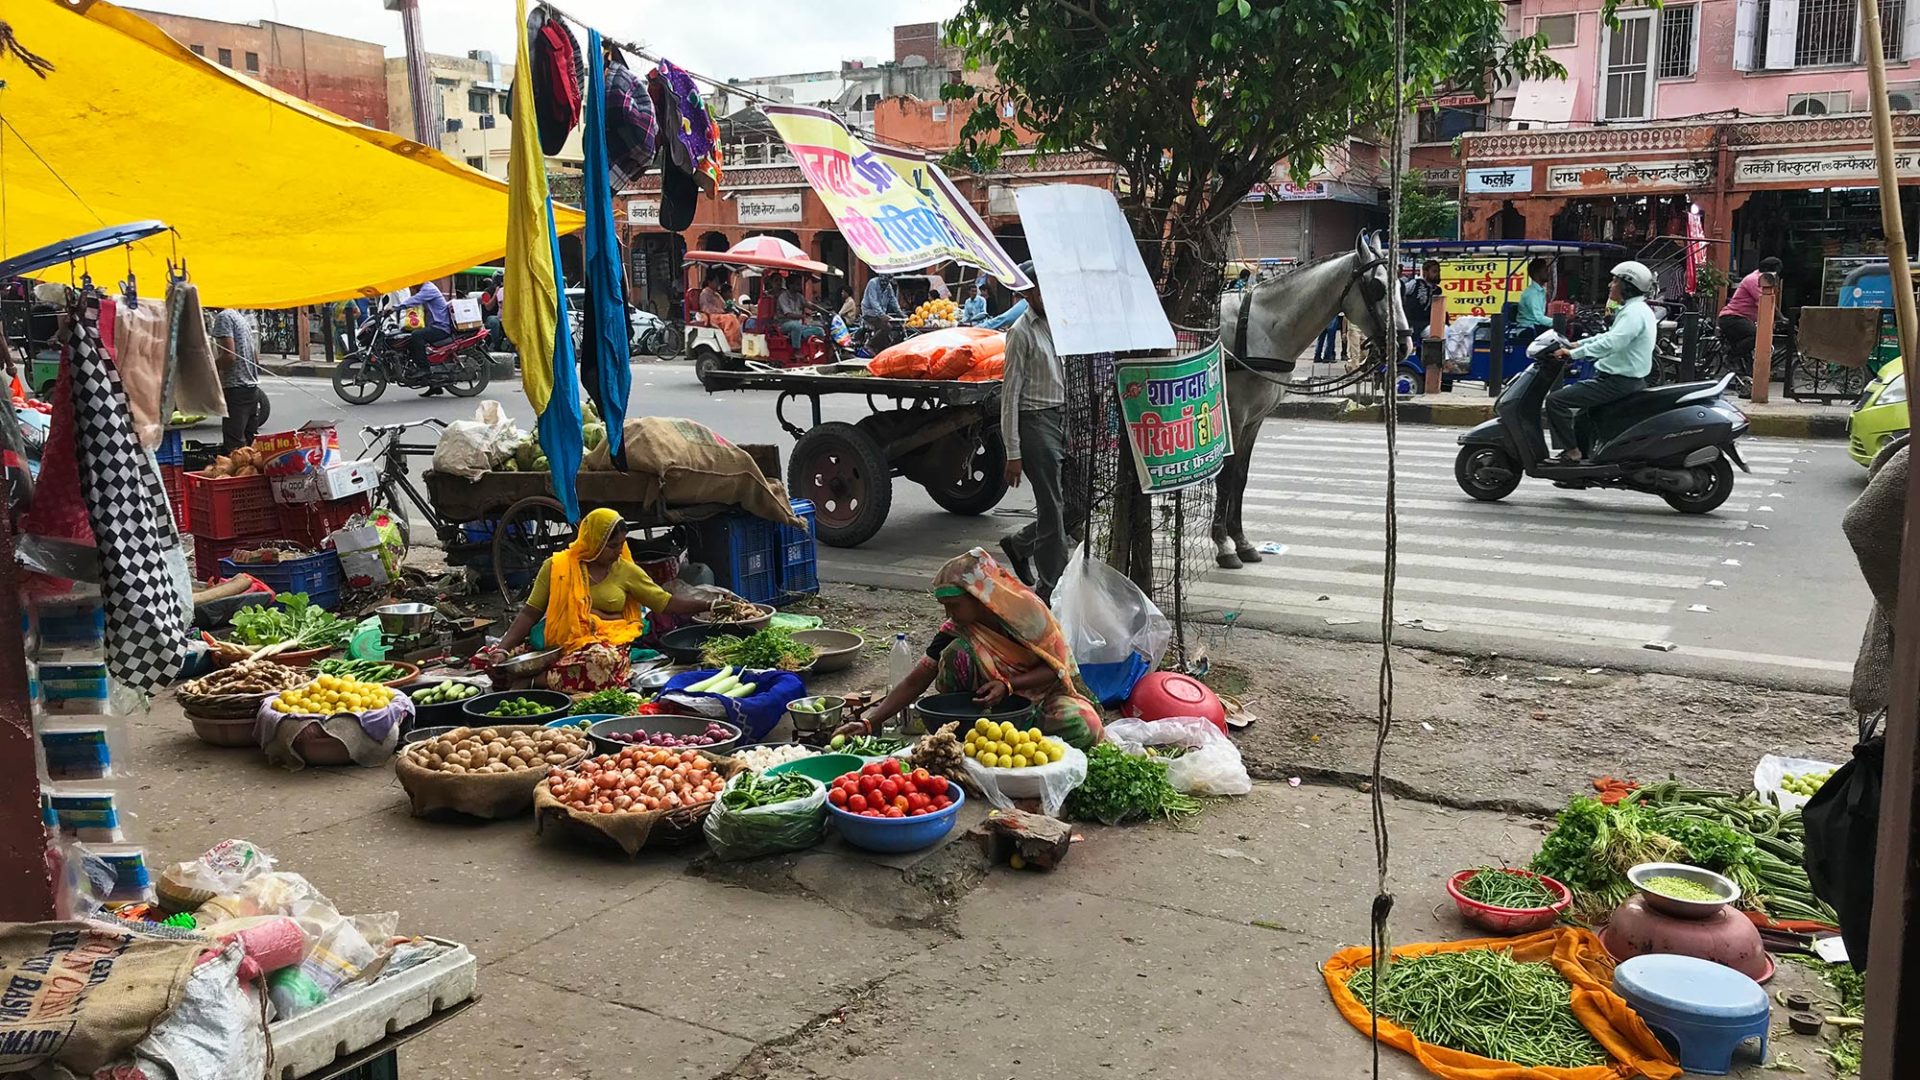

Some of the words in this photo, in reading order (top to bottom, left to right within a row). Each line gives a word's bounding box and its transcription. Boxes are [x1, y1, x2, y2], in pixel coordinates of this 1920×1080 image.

[1742, 160, 1774, 176] लक्की
[1894, 153, 1912, 170] टोर
[1148, 369, 1207, 406] शानदार
[0, 1029, 62, 1055] MATI
